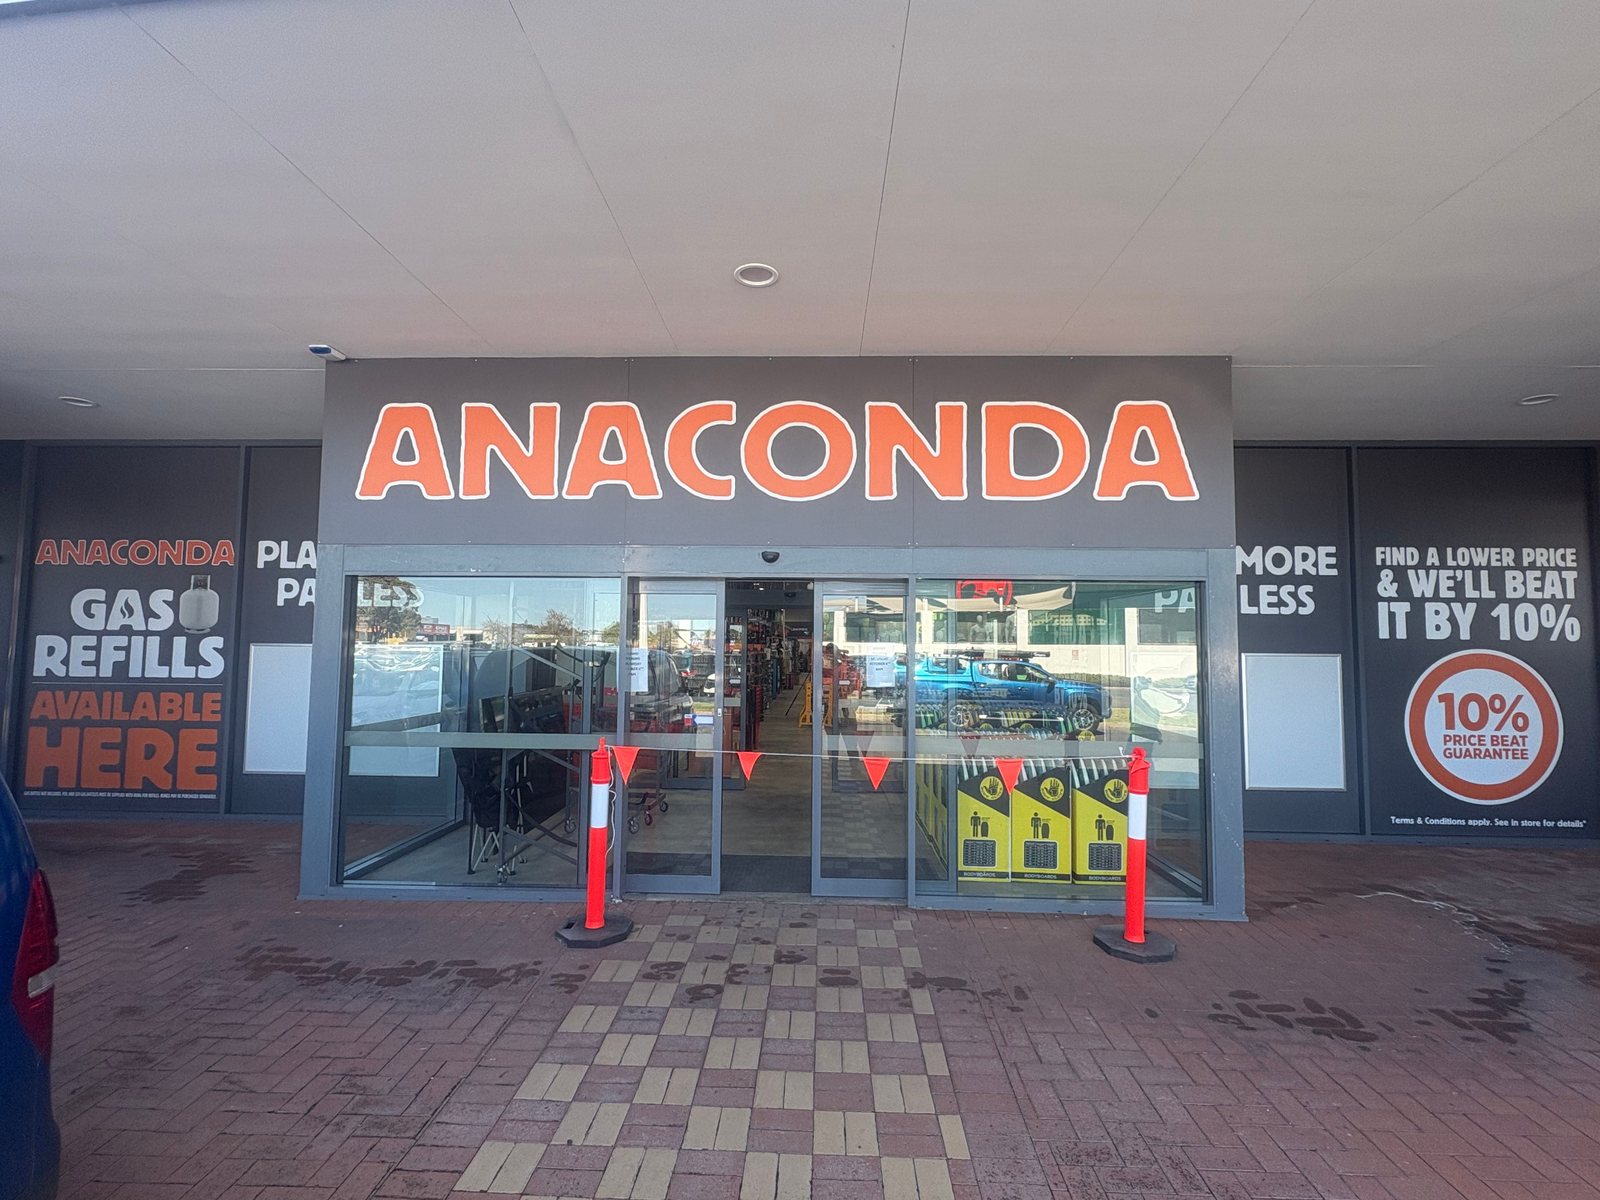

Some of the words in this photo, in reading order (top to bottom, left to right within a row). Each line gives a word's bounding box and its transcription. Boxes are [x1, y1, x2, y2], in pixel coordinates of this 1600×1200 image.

[355, 400, 1200, 502] ANACONDA
[35, 539, 236, 566] ANACONDA
[1235, 545, 1339, 576] MORE
[1375, 546, 1420, 567] FIND
[1426, 547, 1440, 567] A
[1446, 547, 1516, 567] LOWER
[1522, 548, 1577, 567] PRICE
[1240, 584, 1316, 615] LESS
[1377, 569, 1399, 598] &
[1407, 569, 1497, 599] WE'LL
[1505, 570, 1578, 600] BEAT
[70, 588, 175, 632] GAS
[1377, 602, 1411, 640] IT
[1425, 602, 1478, 640] BY
[1490, 603, 1582, 642] 10%
[33, 635, 225, 679] REFILLS
[30, 690, 222, 722] AVAILABLE
[1437, 692, 1530, 733] 10%
[1443, 734, 1487, 747] PRICE
[1490, 735, 1528, 748] BEAT
[1443, 747, 1529, 761] GUARANTEE
[24, 726, 218, 791] HERE
[1390, 816, 1414, 825] Terms
[1416, 817, 1423, 825] &
[1424, 817, 1466, 826] Conditions
[1467, 818, 1493, 827] apply.
[1494, 818, 1509, 827] See
[1520, 819, 1541, 828] store
[1543, 819, 1555, 828] for
